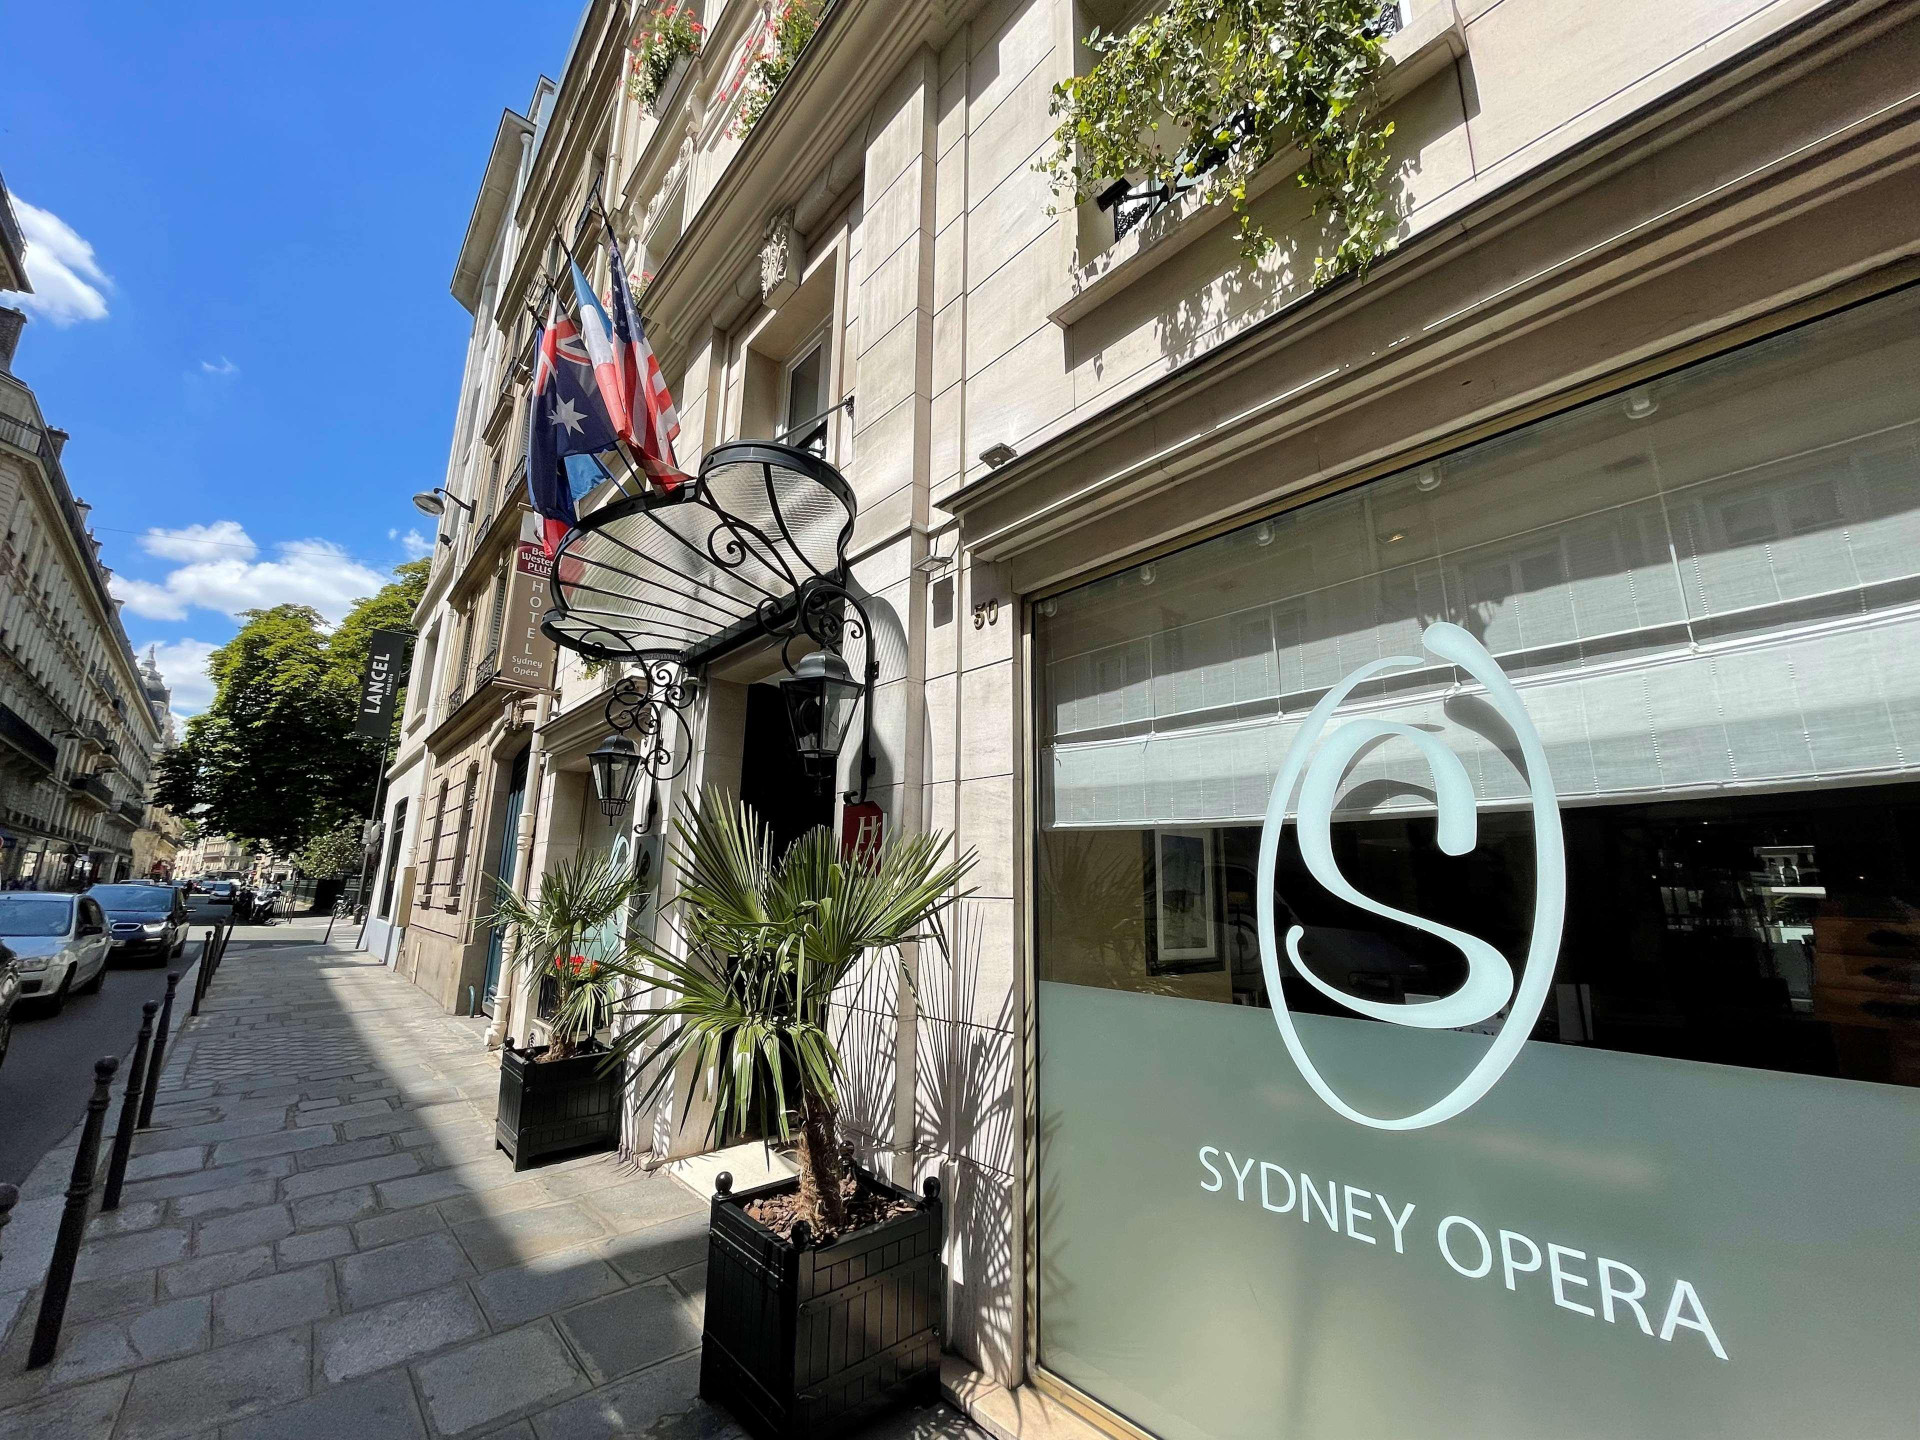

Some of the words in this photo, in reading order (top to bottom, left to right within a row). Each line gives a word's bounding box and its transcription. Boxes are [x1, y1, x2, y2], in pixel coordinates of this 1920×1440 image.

[521, 552, 554, 567] Wester
[527, 562, 552, 575] PLUS
[525, 580, 544, 655] HOTEL
[973, 597, 999, 630] 50
[512, 655, 543, 668] Sydney
[364, 653, 390, 714] LANCEL
[858, 815, 879, 843] H
[1199, 1145, 1416, 1254] SYDNEY
[1437, 1215, 1730, 1361] OPERA
